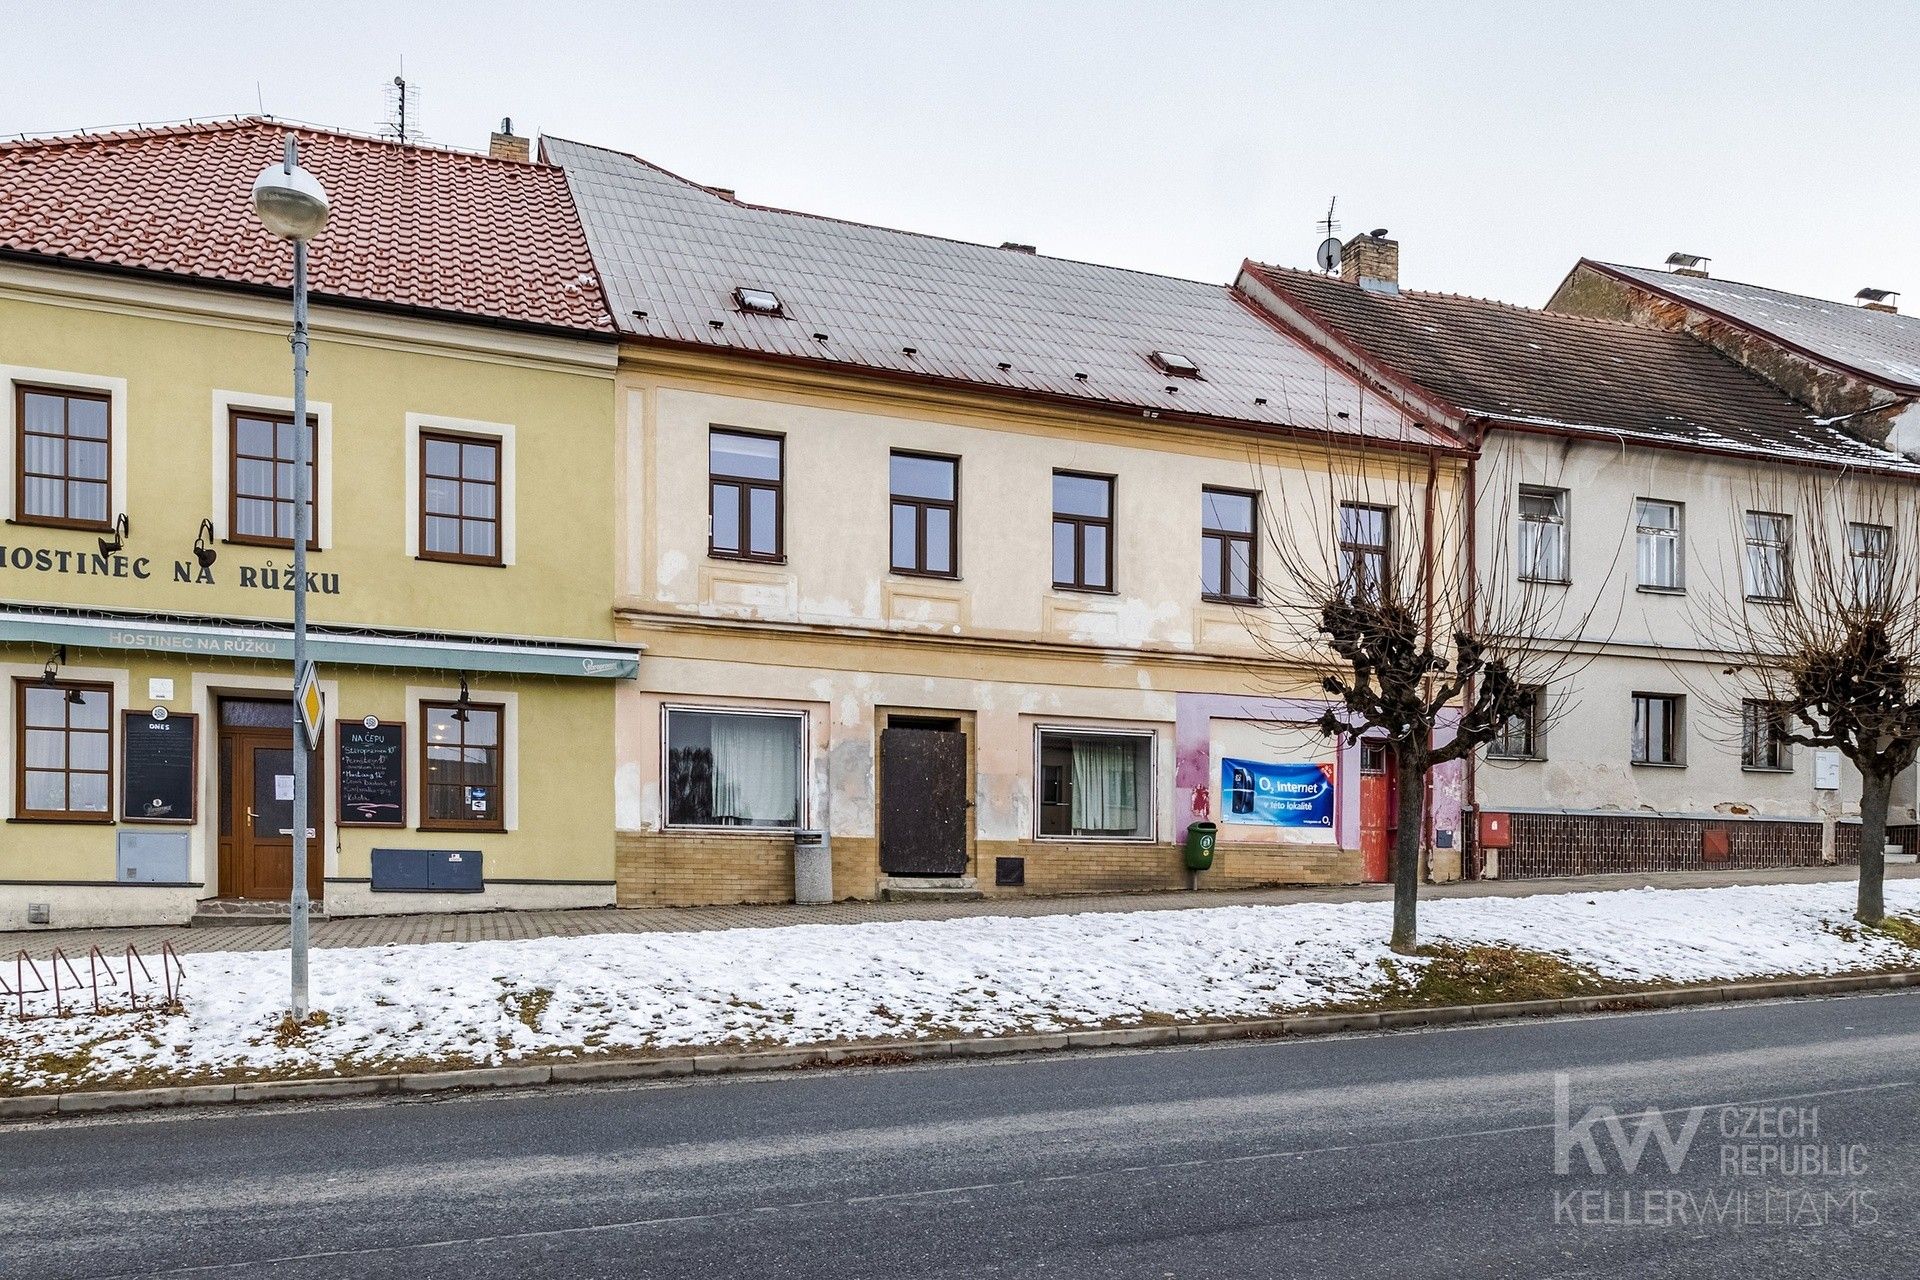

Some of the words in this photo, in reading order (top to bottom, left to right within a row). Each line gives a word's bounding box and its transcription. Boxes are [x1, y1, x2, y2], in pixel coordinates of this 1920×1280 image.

[174, 560, 215, 585] NA
[239, 560, 340, 595] RŮŽKU
[109, 631, 193, 648] HOSTINEC
[197, 638, 220, 651] NA
[224, 637, 276, 654] RŮŽKU
[351, 734, 363, 742] NA
[364, 732, 385, 743] ČEPU
[1270, 801, 1285, 809] této
